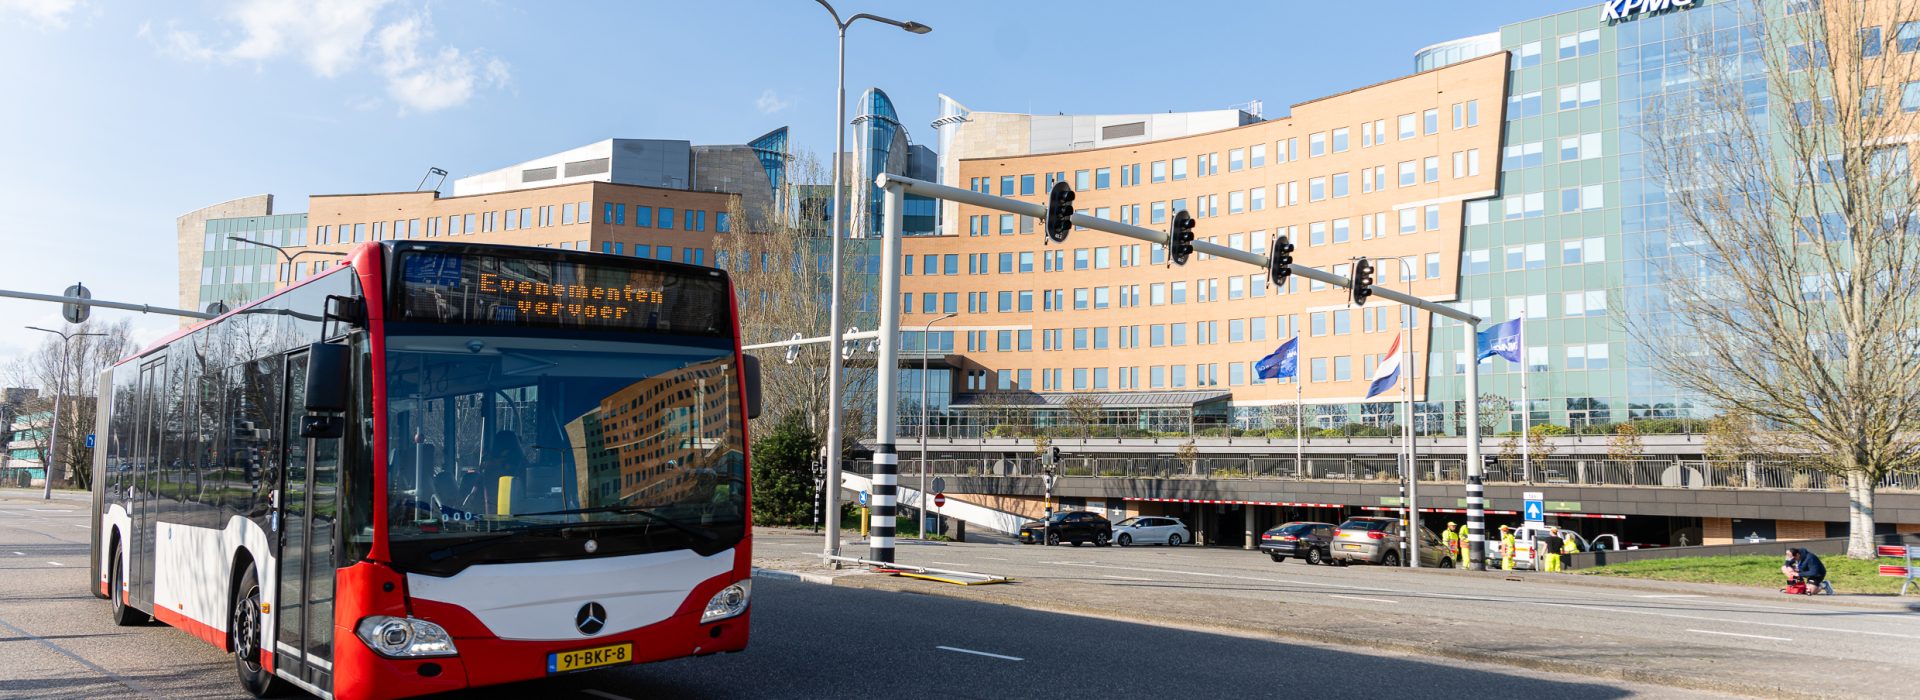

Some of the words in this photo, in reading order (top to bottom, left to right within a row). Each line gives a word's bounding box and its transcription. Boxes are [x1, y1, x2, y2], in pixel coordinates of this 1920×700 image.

[480, 273, 663, 304] Evenementen
[517, 301, 628, 319] vervoer
[563, 646, 626, 668] 91-BKF-8
